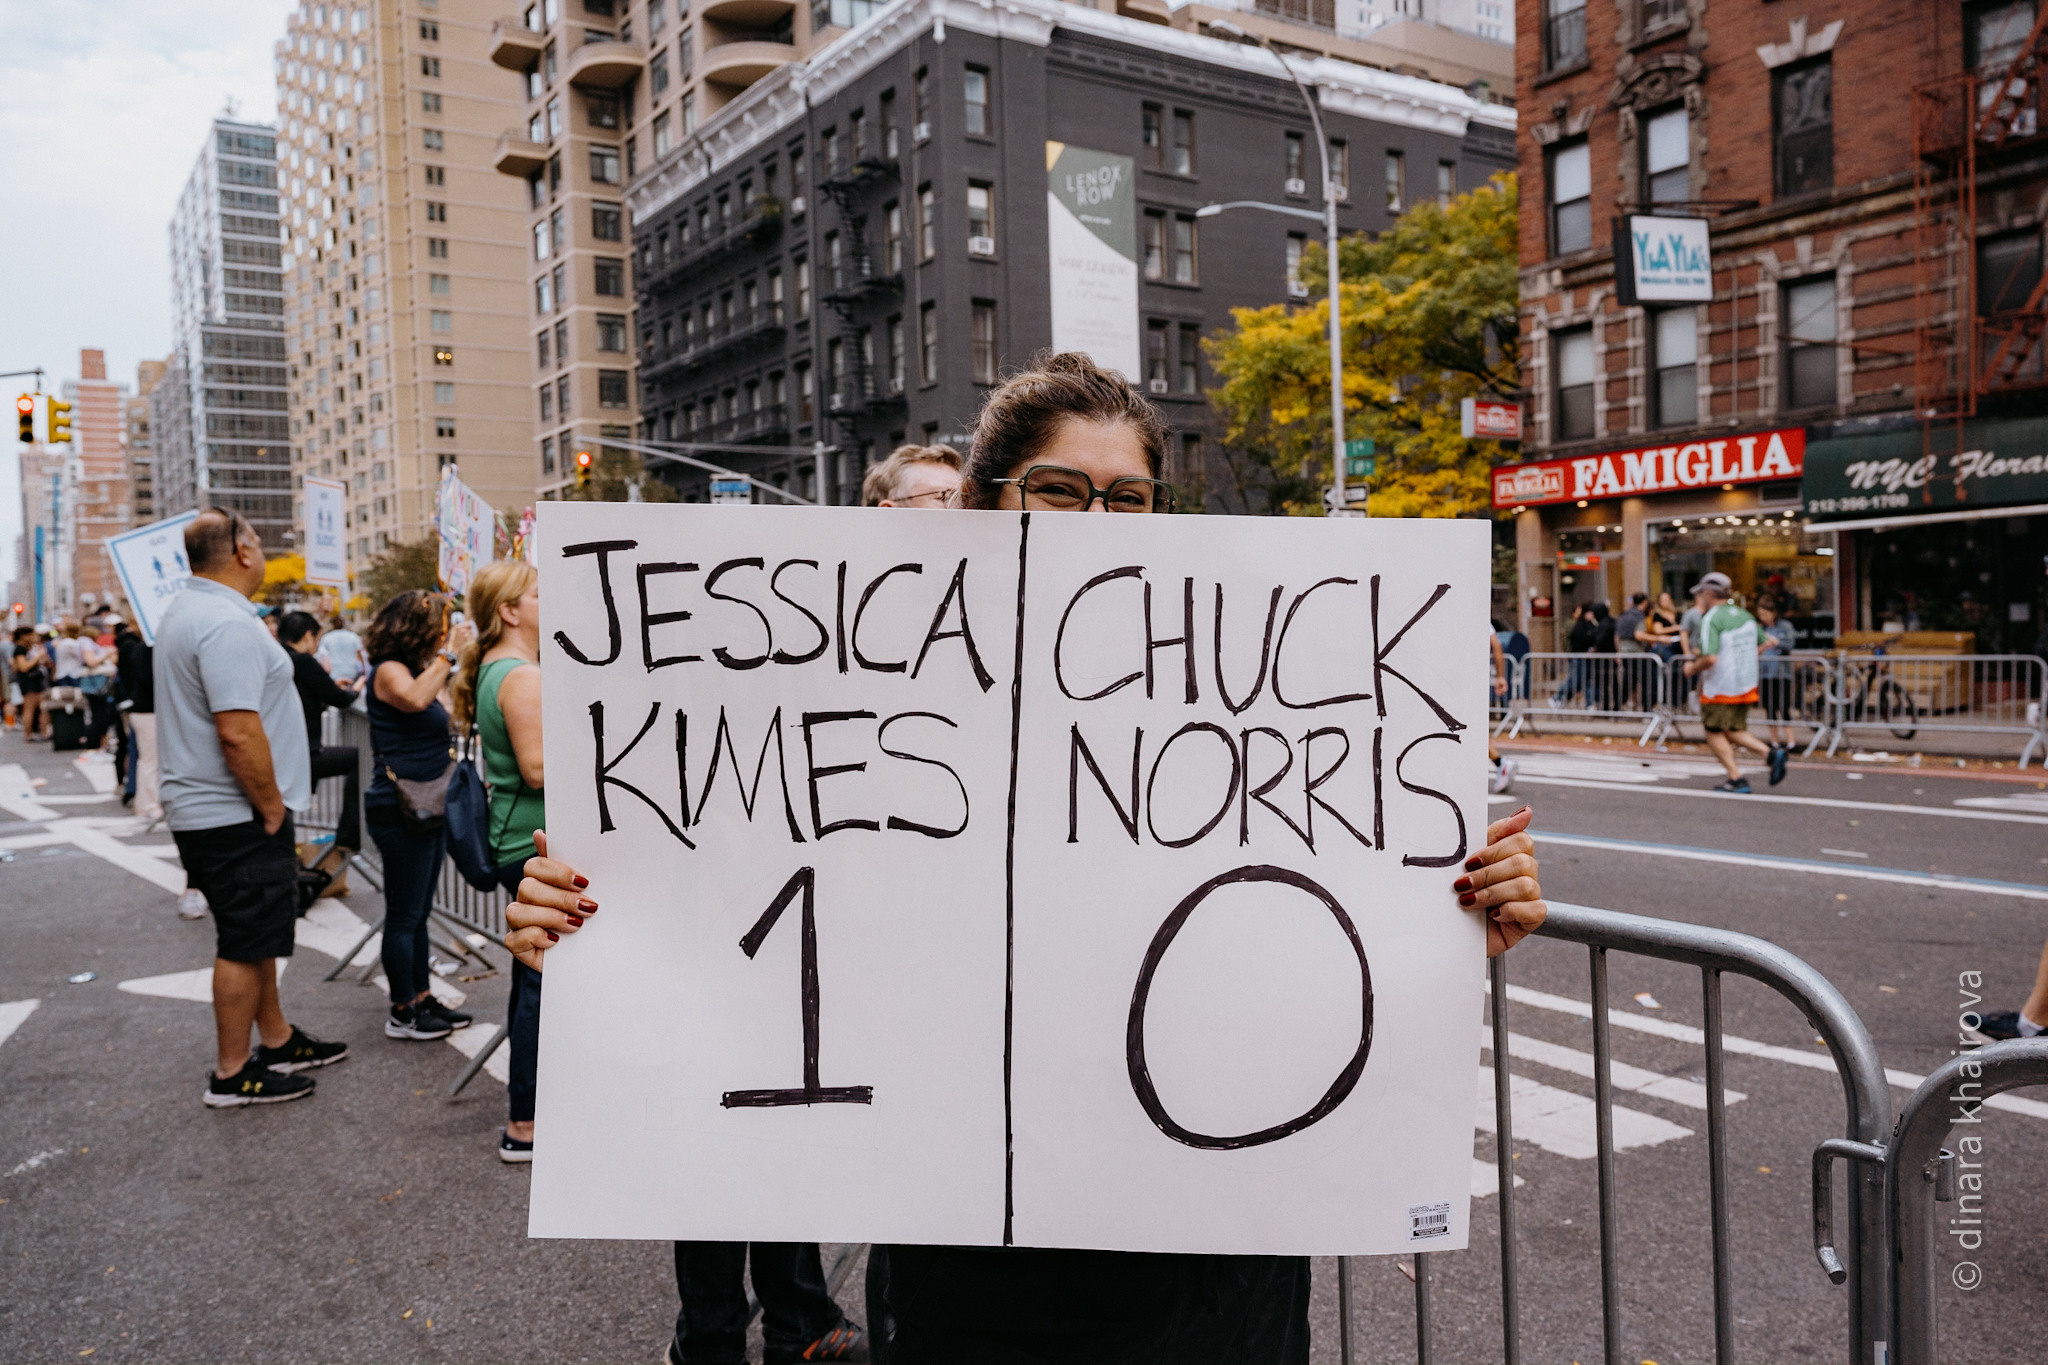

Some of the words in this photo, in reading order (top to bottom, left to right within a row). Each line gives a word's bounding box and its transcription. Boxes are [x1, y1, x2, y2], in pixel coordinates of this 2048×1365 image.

[1065, 164, 1122, 192] LENOX
[1076, 182, 1117, 207] ROW
[1572, 432, 1797, 499] FAMIGLIA
[1845, 454, 1938, 494] NYC
[554, 540, 995, 693] JESSICA
[1054, 566, 1467, 732] CHUCK
[588, 701, 968, 850] KIMES
[1067, 722, 1467, 868] NORRIS
[720, 866, 873, 1109] 1
[1127, 865, 1373, 1150] 0
